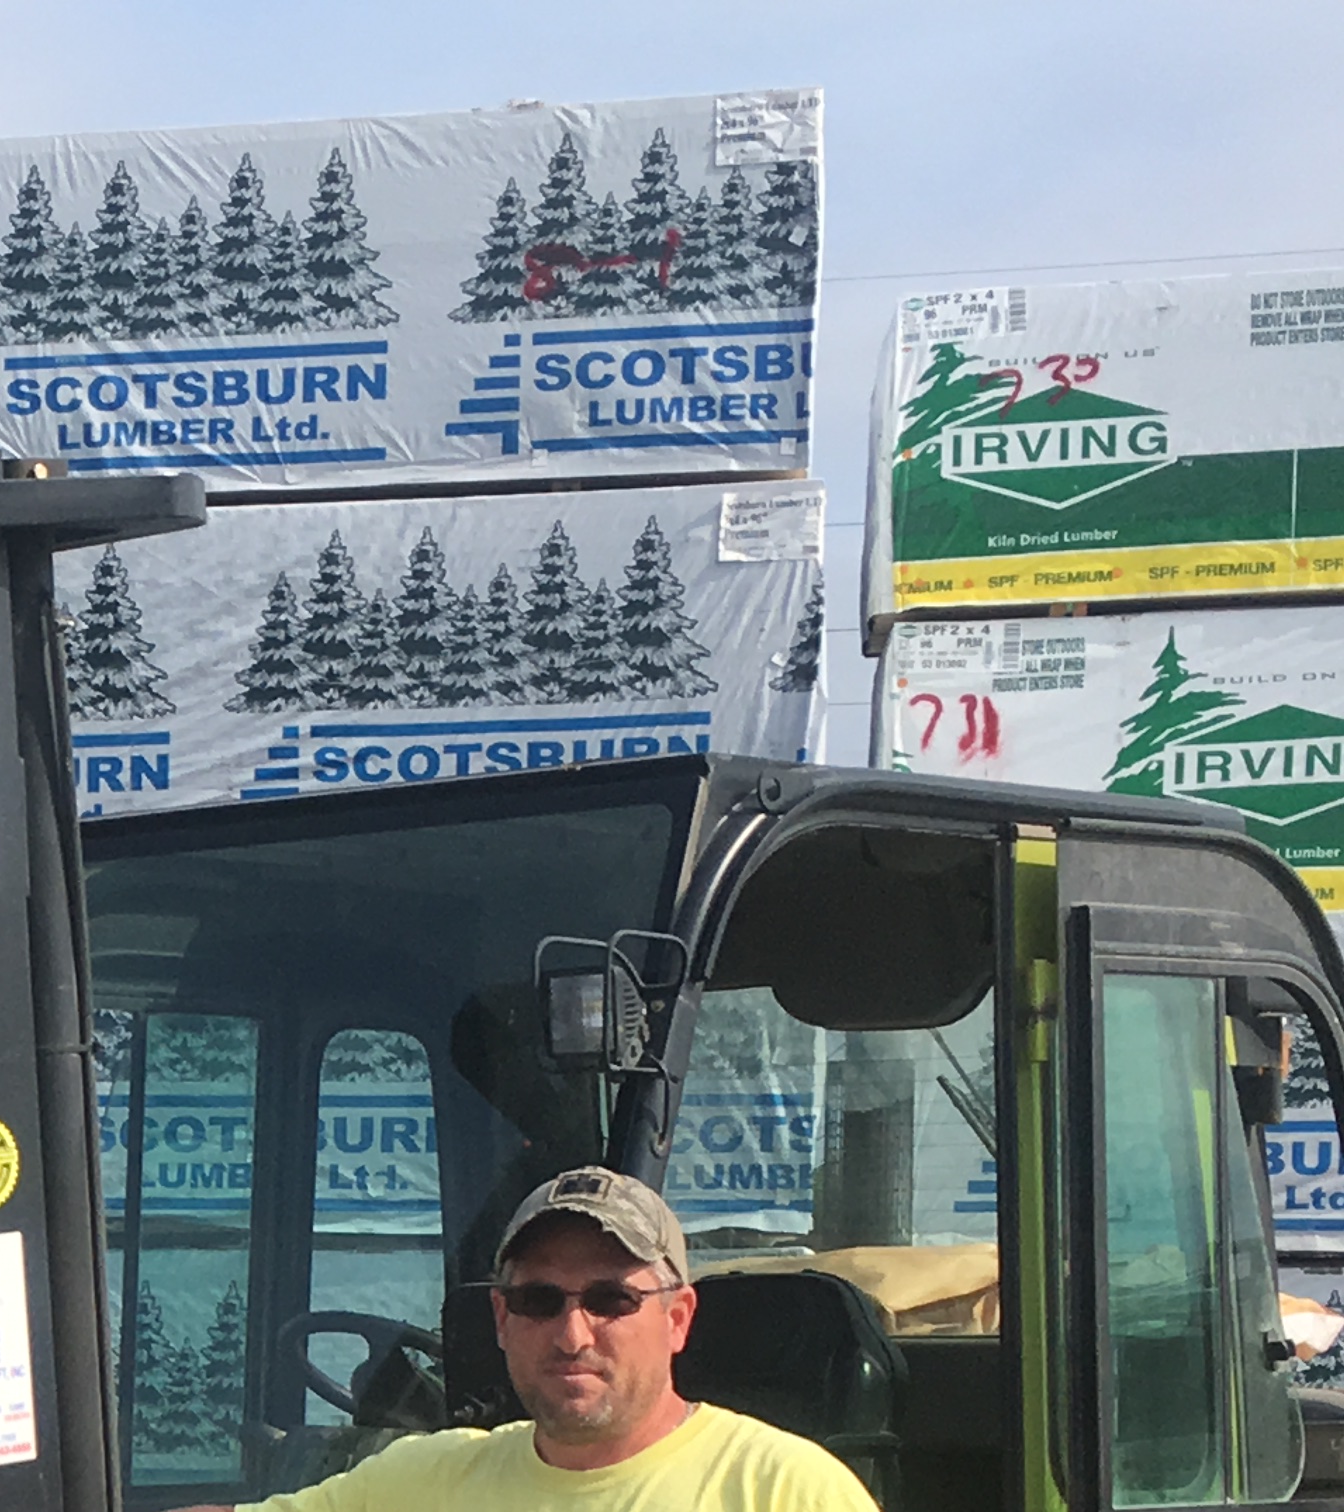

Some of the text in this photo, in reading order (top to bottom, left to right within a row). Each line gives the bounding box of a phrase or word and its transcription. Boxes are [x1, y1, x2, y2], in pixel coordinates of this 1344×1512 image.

[953, 293, 963, 304] 2
[984, 289, 995, 300] 4
[1124, 348, 1156, 358] US
[5, 364, 388, 416] SCOTSBURN
[587, 392, 779, 428] LUMBER
[57, 414, 331, 451] LUMBER Ltd.
[951, 421, 1170, 468] IRVING
[987, 529, 1119, 549] Kiln Dried Lumber
[988, 570, 1114, 589] SPF PREMIUM
[1148, 561, 1276, 580] SPF PREMIUM
[924, 624, 991, 636] SPF 2 x 4
[957, 637, 983, 649] PRM
[1211, 671, 1337, 685] BUILD ON
[909, 693, 943, 752] 7
[1173, 742, 1344, 785] IRVIN
[1284, 846, 1341, 859] Lumber
